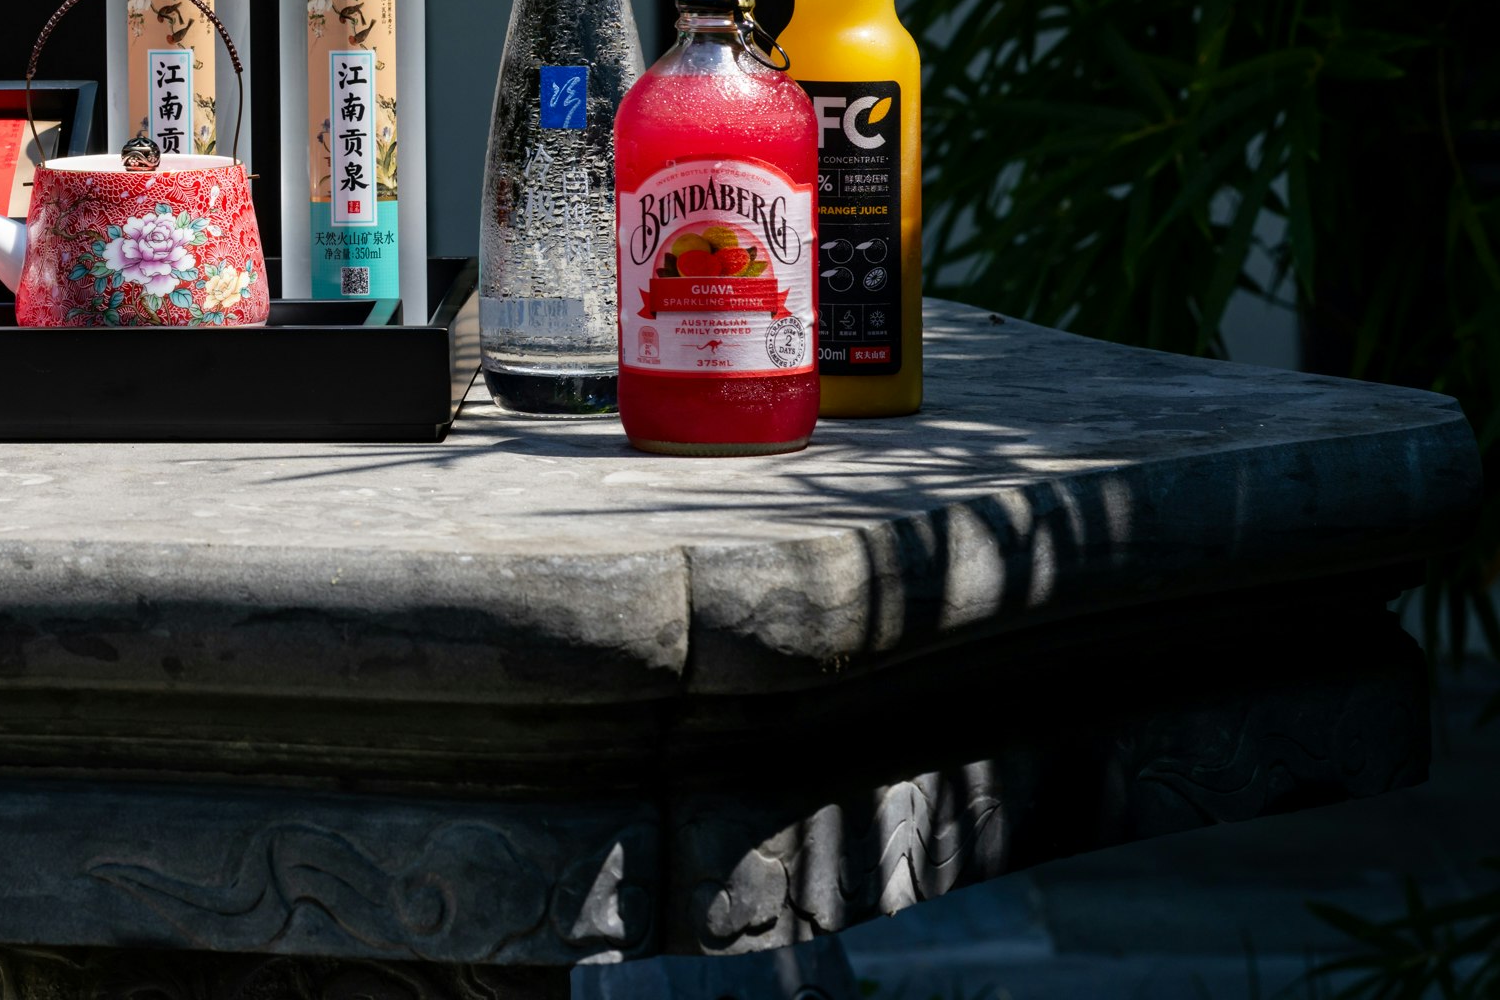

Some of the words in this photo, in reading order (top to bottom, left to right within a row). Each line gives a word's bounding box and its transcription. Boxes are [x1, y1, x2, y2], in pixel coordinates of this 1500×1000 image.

[156, 61, 185, 154] 江南贡
[338, 62, 370, 192] 江南贡泉
[813, 95, 886, 149] FC
[823, 155, 885, 164] CONCENTRATE
[655, 173, 679, 187] INVERT
[680, 168, 709, 177] BOTTLE
[710, 168, 740, 177] BEFORE
[818, 206, 857, 215] RANGE
[858, 205, 888, 215] JUICE
[630, 175, 800, 266] BUNDABERG
[315, 230, 395, 246] 天然火山矿泉水
[691, 284, 735, 295] GUAVA
[663, 297, 725, 307] SPARKLING
[729, 297, 764, 307] DRINK
[681, 318, 747, 327] AUSTRALIAN
[675, 327, 710, 335] FAMILY
[713, 327, 751, 335] OWNED
[785, 334, 793, 347] 2
[779, 346, 796, 355] DAYS
[818, 347, 846, 361] 00ml
[855, 350, 886, 360] 农夫山泉
